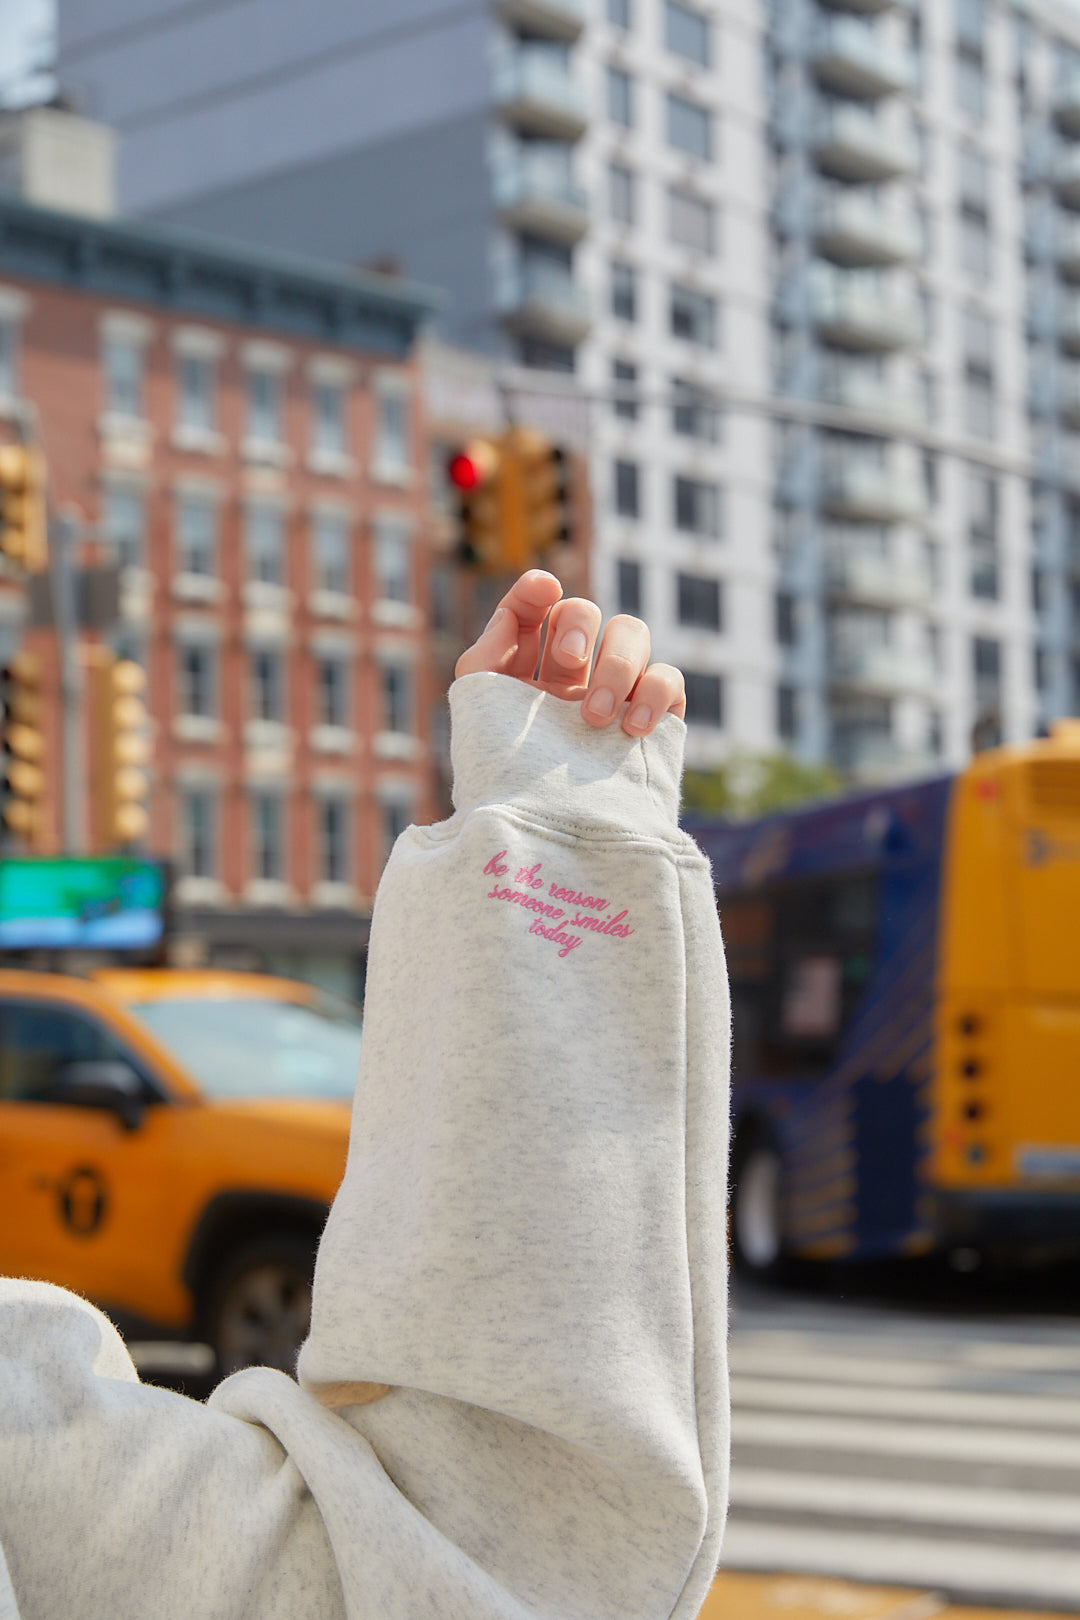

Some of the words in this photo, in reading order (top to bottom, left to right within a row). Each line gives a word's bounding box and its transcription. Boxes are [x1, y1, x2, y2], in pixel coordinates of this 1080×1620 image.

[483, 850, 510, 877] be
[514, 863, 545, 889] the
[548, 883, 611, 911] reason
[487, 884, 565, 920] someone
[570, 909, 635, 938] smiles
[528, 917, 583, 958] today
